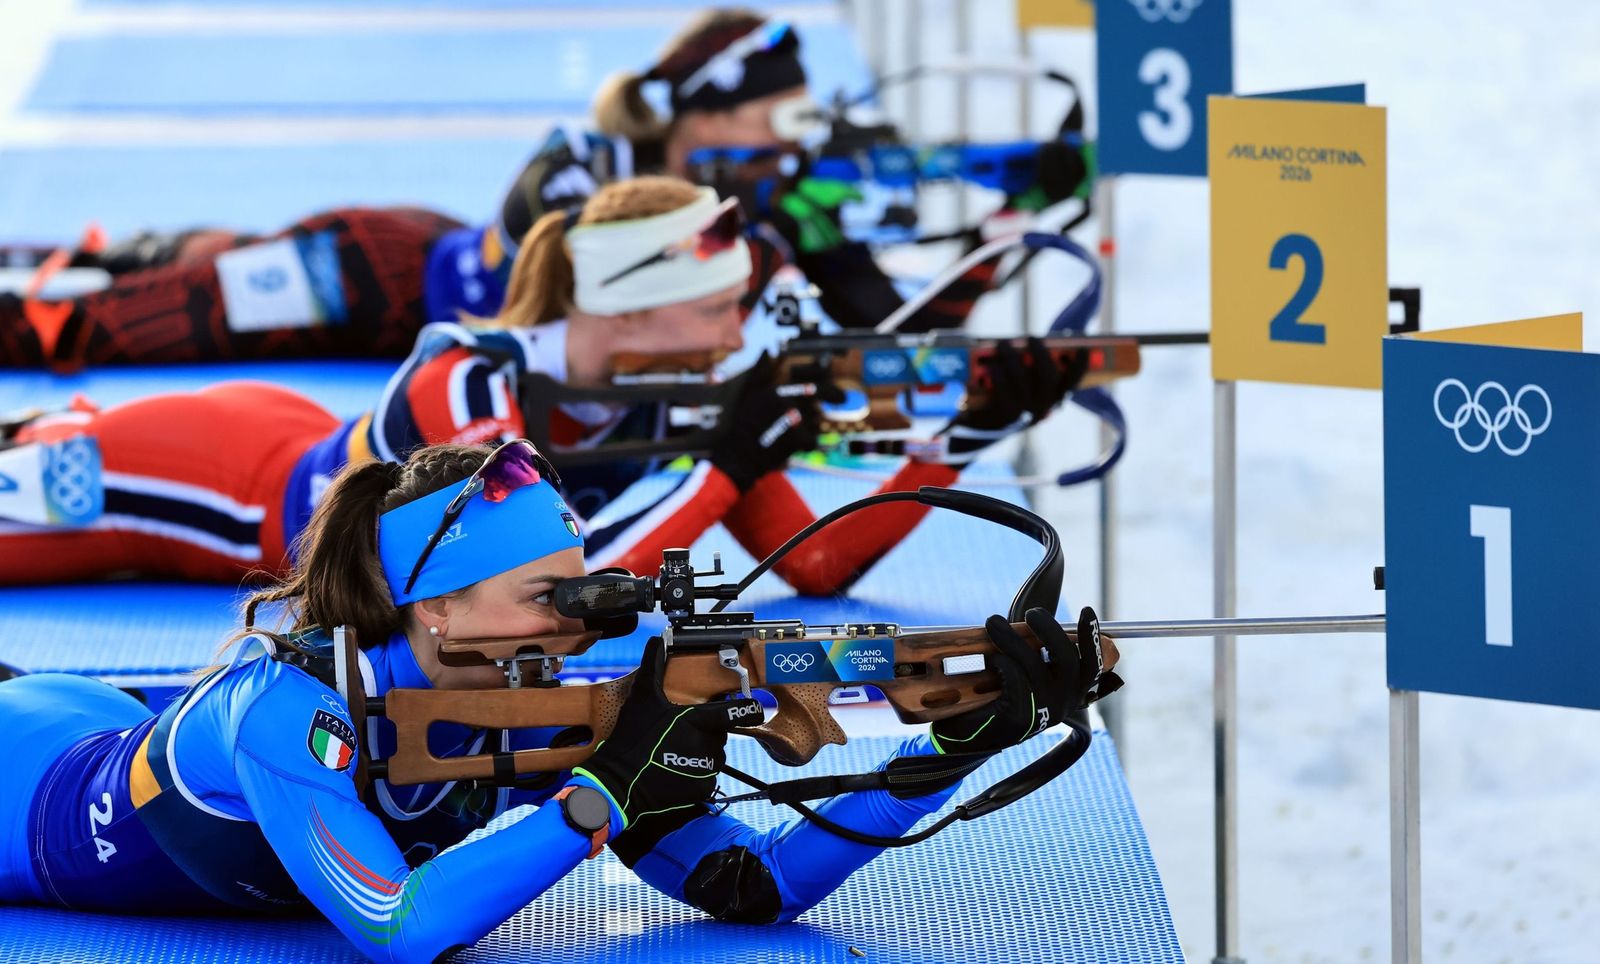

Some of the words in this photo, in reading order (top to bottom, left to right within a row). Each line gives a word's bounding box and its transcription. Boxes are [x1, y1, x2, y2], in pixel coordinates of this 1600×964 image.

[1138, 47, 1193, 152] 3
[1227, 143, 1293, 162] MILANO
[1297, 147, 1367, 167] CORTINA
[1279, 164, 1313, 182] 2026
[1268, 231, 1326, 346] 2
[1470, 504, 1513, 647] 1
[844, 649, 882, 657] MILANO
[851, 656, 889, 664] CORTINA
[319, 713, 356, 745] ITALIA
[89, 791, 118, 864] 24
